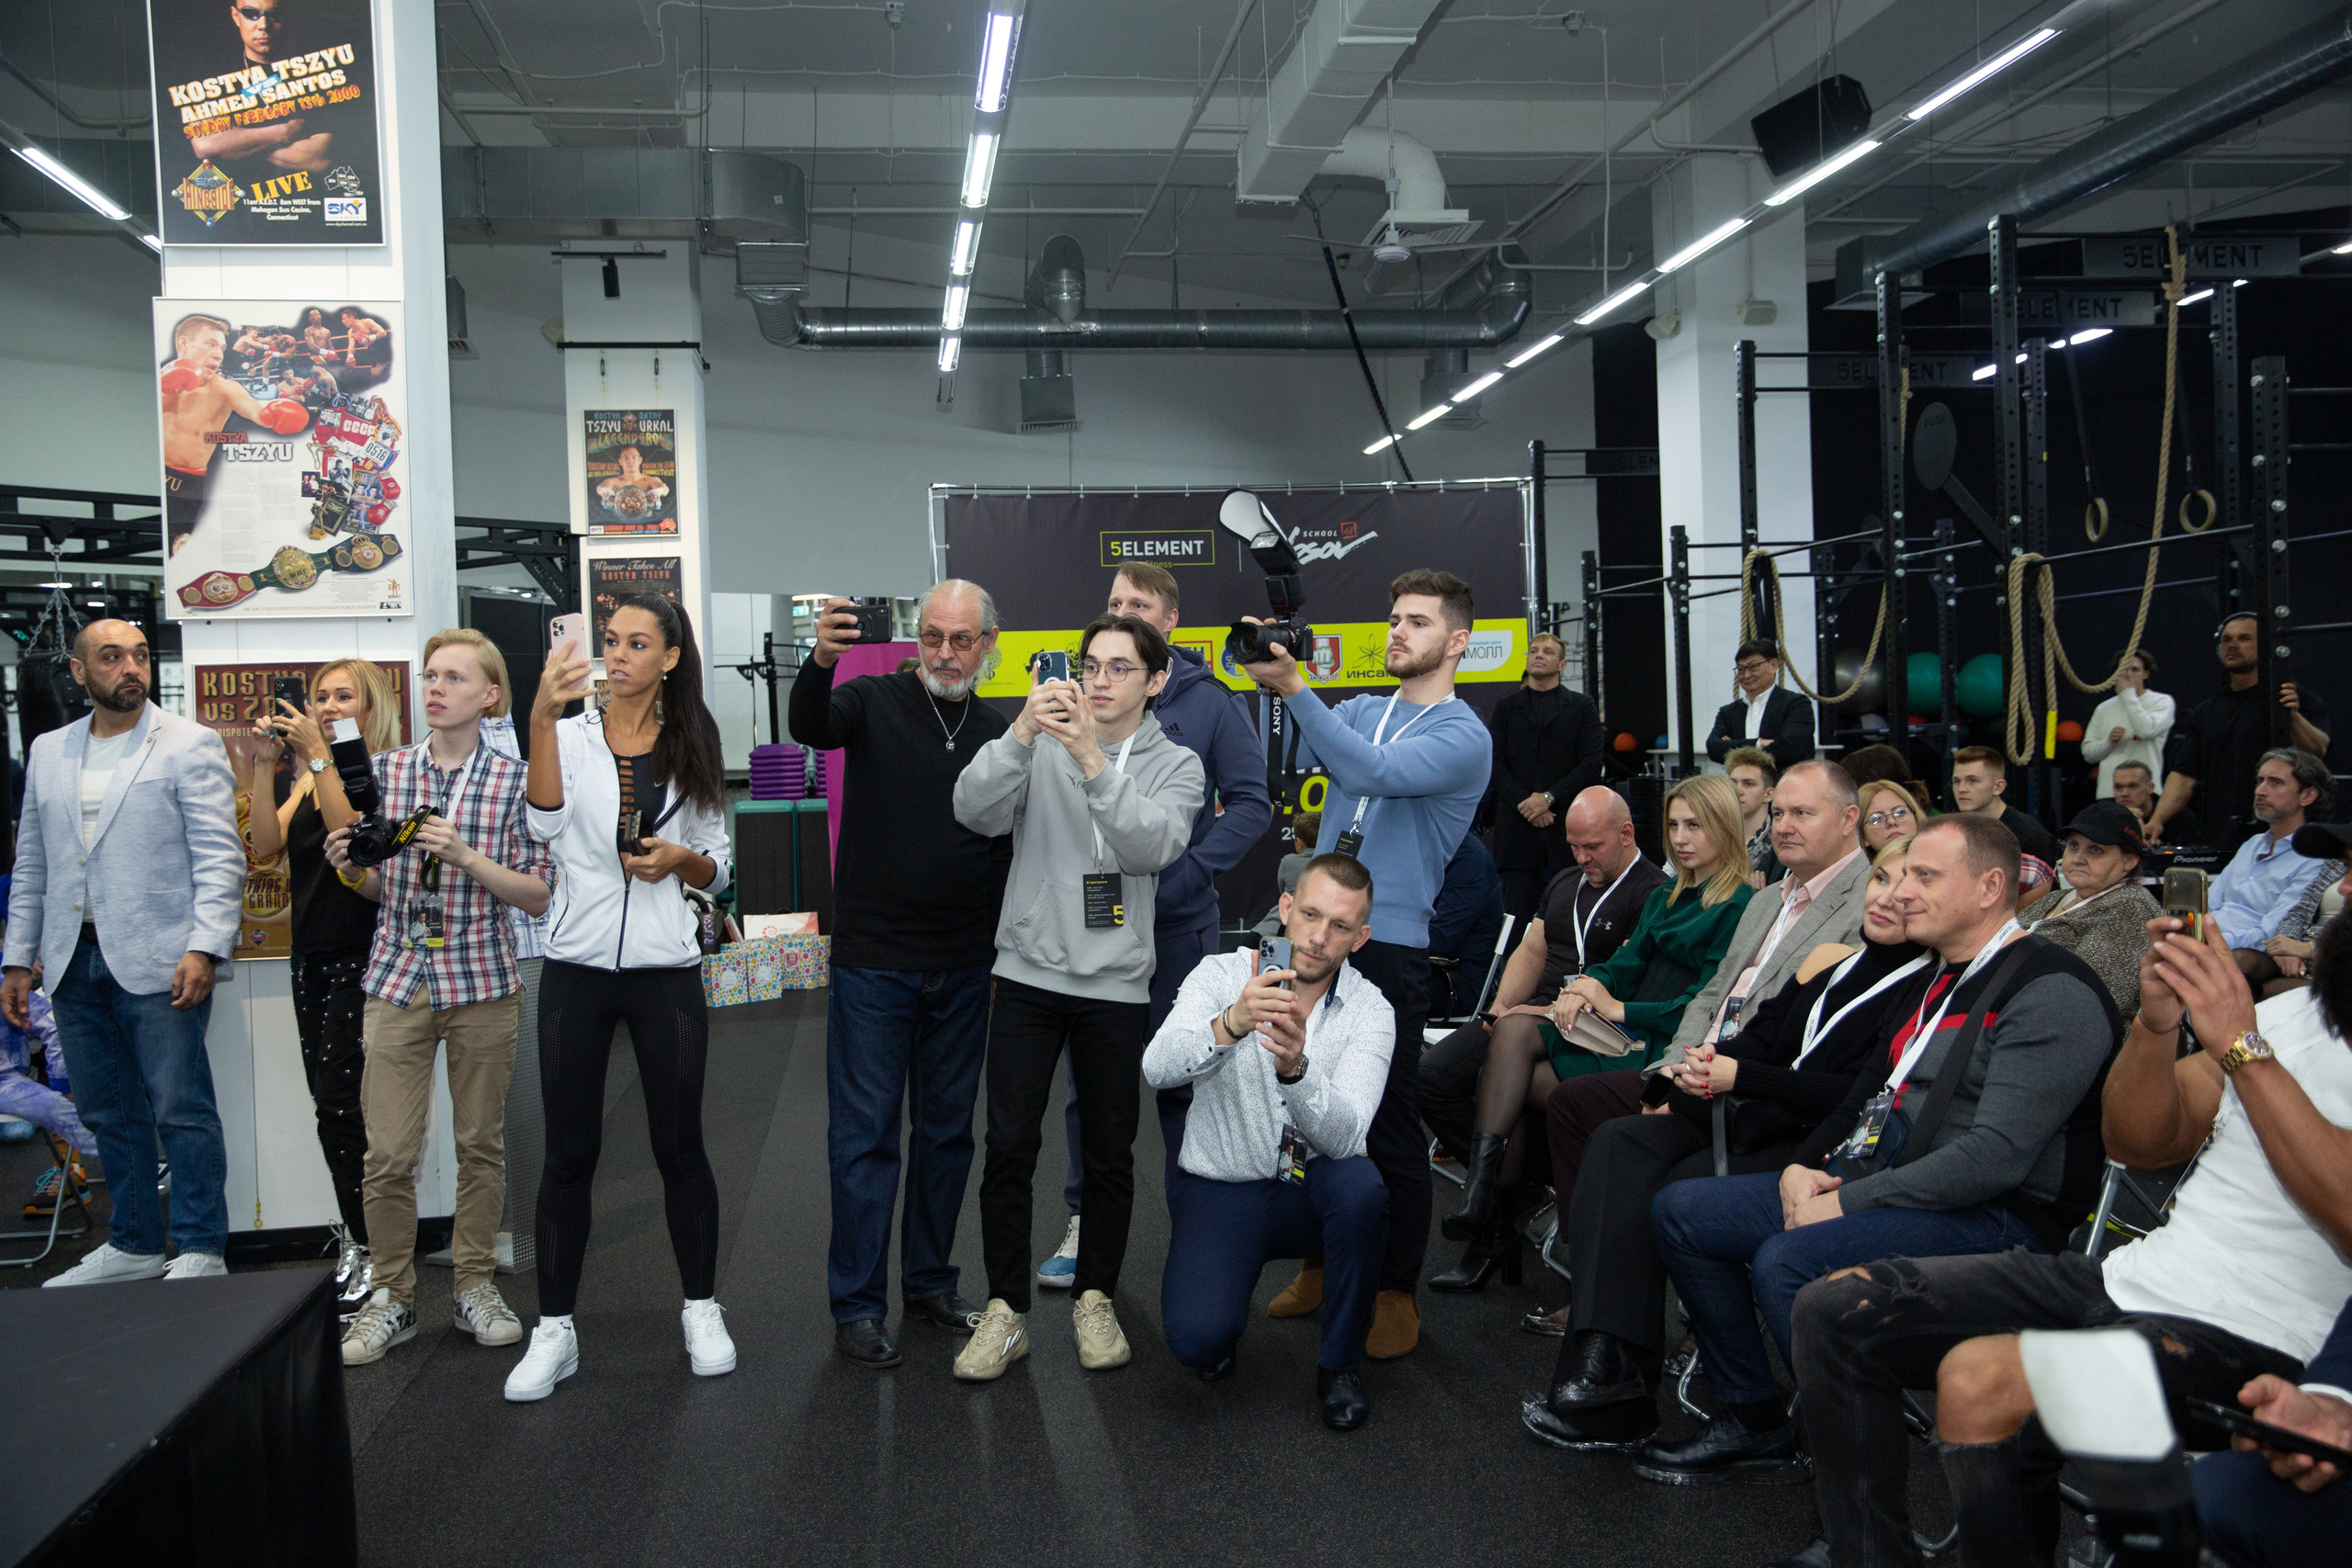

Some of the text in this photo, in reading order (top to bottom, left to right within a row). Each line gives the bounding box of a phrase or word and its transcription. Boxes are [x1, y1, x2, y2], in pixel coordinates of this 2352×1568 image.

[168, 43, 355, 107] KOSTYA TSZYU
[181, 69, 347, 123] AHMED SANTOS
[184, 115, 232, 140] SUNDAY
[234, 100, 296, 127] FEBRUARY
[327, 85, 360, 104] 2000
[183, 177, 235, 210] RINGSIDE
[251, 171, 312, 202] LIVE
[327, 202, 364, 215] SKY
[2123, 244, 2263, 269] 5ELMENT
[2017, 298, 2122, 318] ELEENT
[1838, 363, 1947, 380] 5ELENT
[586, 421, 621, 433] TSZYU
[639, 420, 674, 433] URKAL
[204, 433, 248, 444] KOSTYA
[598, 433, 638, 447] LEGEND
[222, 443, 294, 462] TSZYU
[366, 442, 389, 462] 0516
[1110, 540, 1204, 557] 5ELEMENT
[657, 558, 678, 570] All
[203, 670, 309, 698] KOSTA
[1272, 696, 1282, 736] SONY
[399, 821, 417, 843] Nikon
[2173, 855, 2219, 863] Pioneer
[246, 877, 281, 894] THING
[1113, 905, 1124, 925] 5
